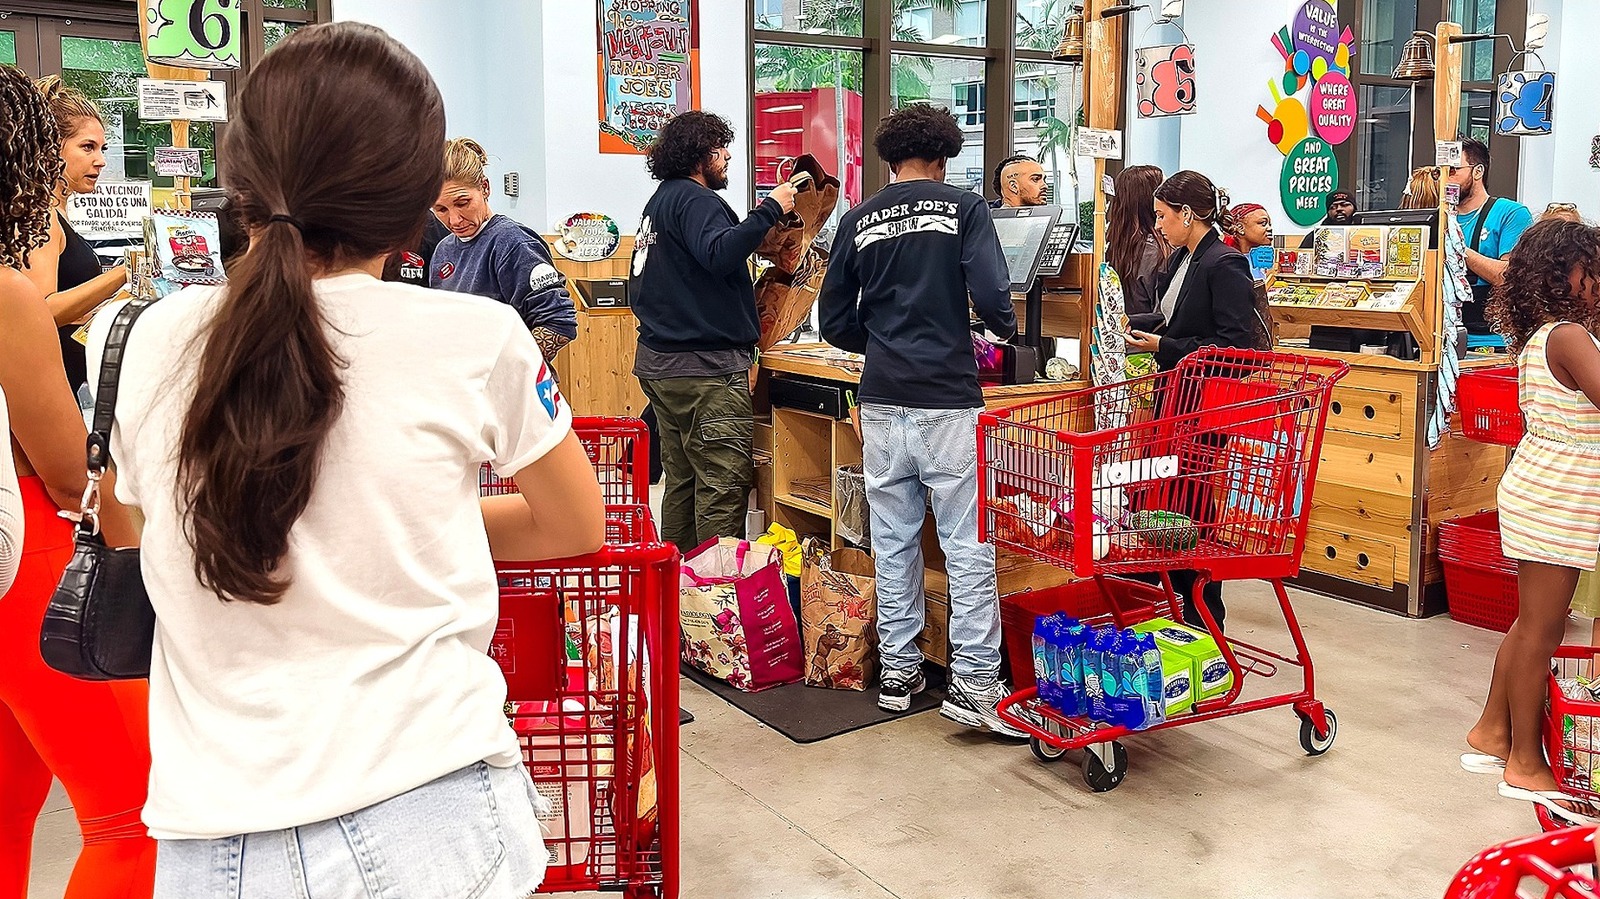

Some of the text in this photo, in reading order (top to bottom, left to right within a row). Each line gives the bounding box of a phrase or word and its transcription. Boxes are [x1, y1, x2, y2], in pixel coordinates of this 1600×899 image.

[1305, 4, 1336, 28] VALUE
[189, 0, 231, 50] 6
[1298, 31, 1335, 54] INTERSECTION
[610, 59, 683, 81] TRADER
[1174, 58, 1196, 105] 5
[1319, 82, 1349, 97] WHERE
[1322, 98, 1347, 111] GREAT
[1532, 83, 1553, 122] 4
[1318, 114, 1352, 127] QUALITY
[1304, 141, 1322, 154] AND
[1294, 156, 1331, 174] GREAT
[105, 185, 143, 196] VECINO!
[1289, 175, 1333, 193] PRICES
[73, 197, 148, 208] ESTO NO ES UNA
[1296, 195, 1320, 210] MEET.
[86, 208, 127, 219] SALIDA!
[856, 200, 959, 232] TRADER JOE'S
[581, 228, 605, 236] YOUR
[887, 217, 919, 236] CREW
[400, 267, 424, 279] CREW
